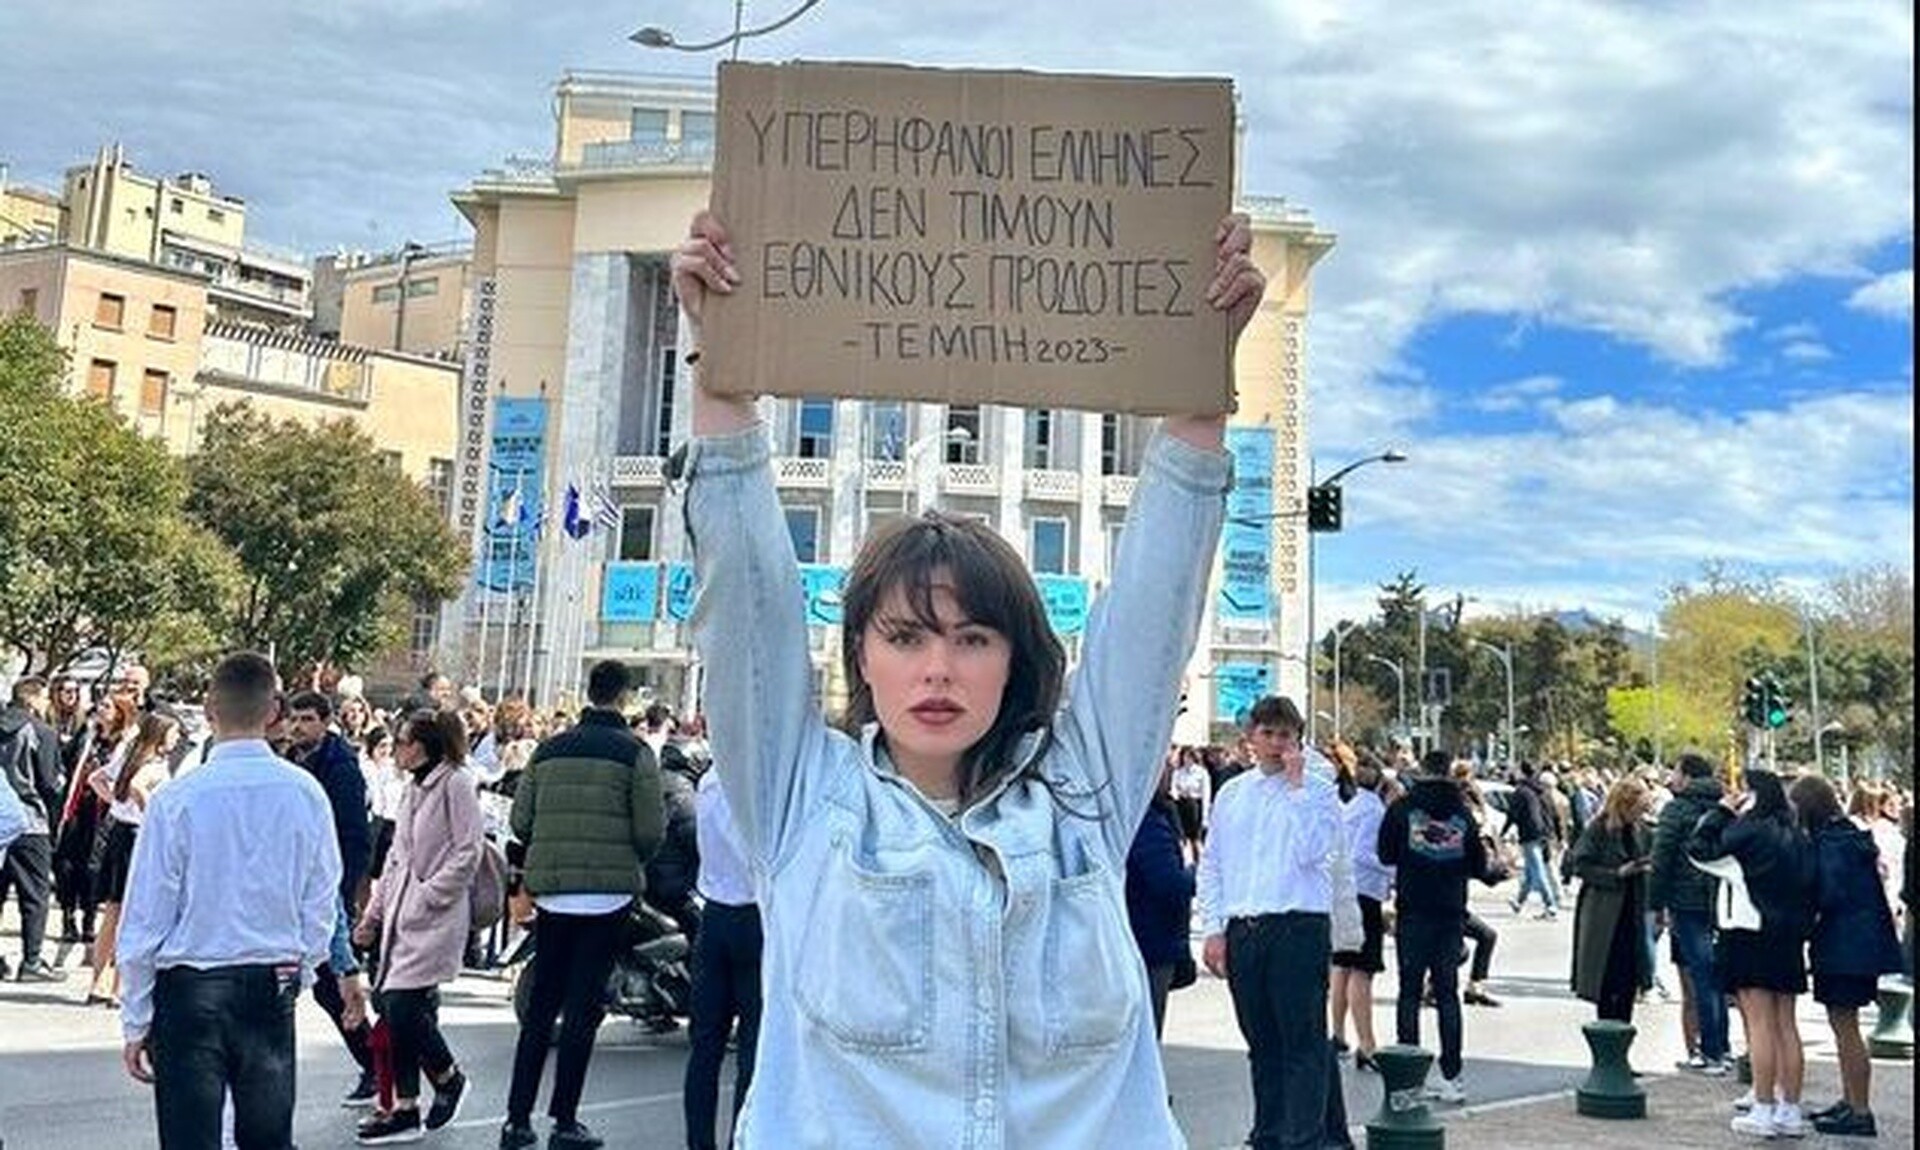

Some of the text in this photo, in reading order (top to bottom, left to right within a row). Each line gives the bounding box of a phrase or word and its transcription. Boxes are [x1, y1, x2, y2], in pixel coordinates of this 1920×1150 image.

[746, 109, 1213, 188] ΥΠΕΡΗΦΑΝΟΙ ΕΛΛΗΝΕΣ
[832, 184, 1114, 249] ΔΕΝ ΤΙΜΟΥΝ
[763, 241, 1194, 317] ΕΘΝΙΚΟΥΣ ΠΡΟΔΟΤΕΣ
